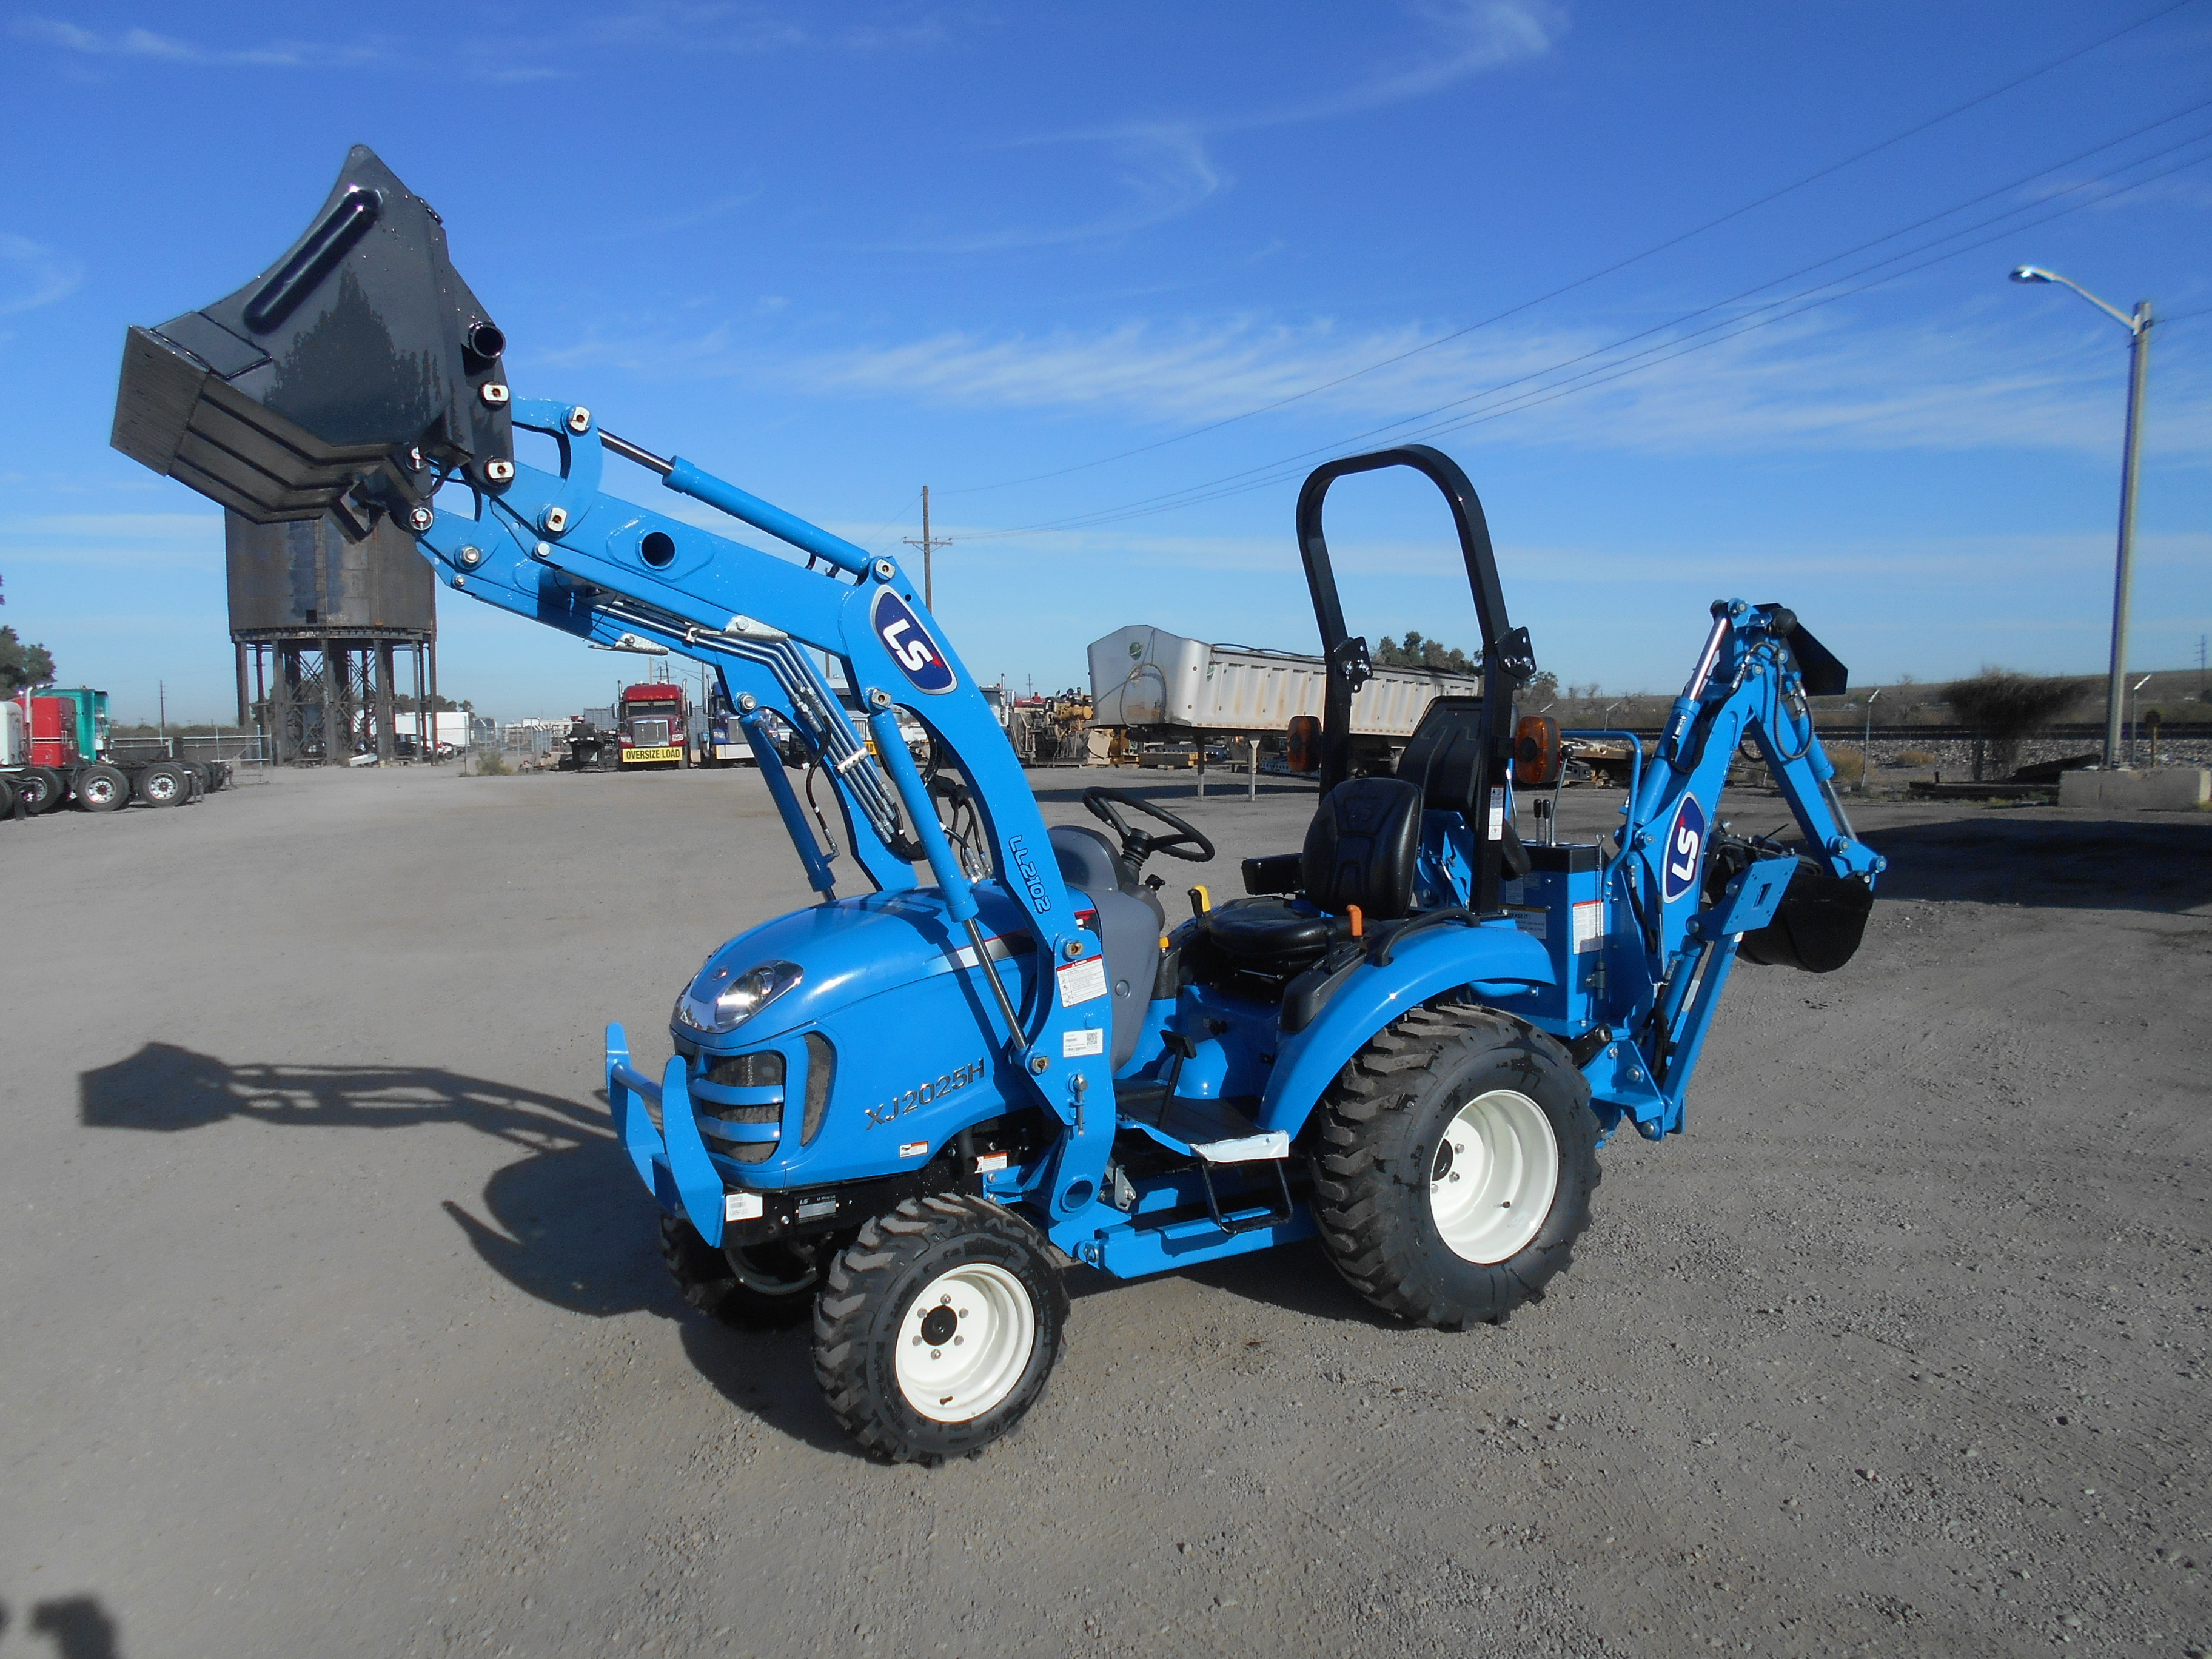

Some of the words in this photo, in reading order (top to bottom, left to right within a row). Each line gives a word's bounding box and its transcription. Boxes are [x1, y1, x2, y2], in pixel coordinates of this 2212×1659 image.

[883, 618, 934, 671] LS
[626, 750, 660, 759] OVERSIZE
[662, 749, 680, 758] LOAD
[1008, 834, 1051, 914] LL2102
[1671, 826, 1698, 881] LS
[865, 1057, 984, 1131] XJ2025H
